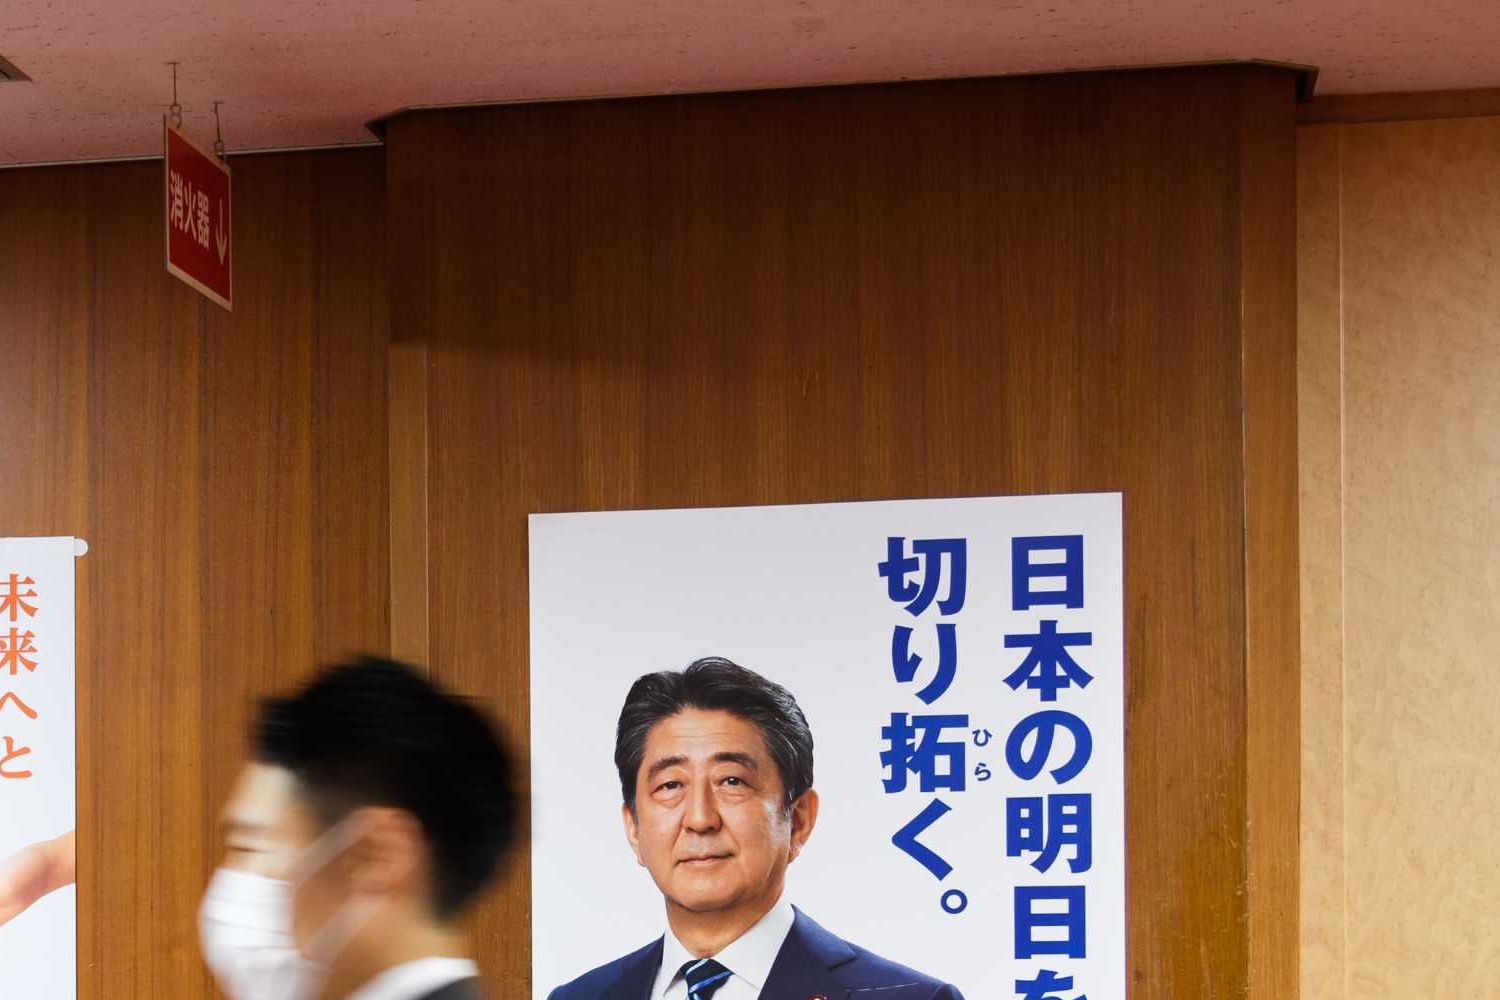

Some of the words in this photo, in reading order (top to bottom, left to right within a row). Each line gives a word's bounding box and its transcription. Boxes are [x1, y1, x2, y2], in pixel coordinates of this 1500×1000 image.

[170, 168, 210, 250] 消火器
[877, 536, 968, 915] 切り拓く。
[971, 727, 993, 782] ひら
